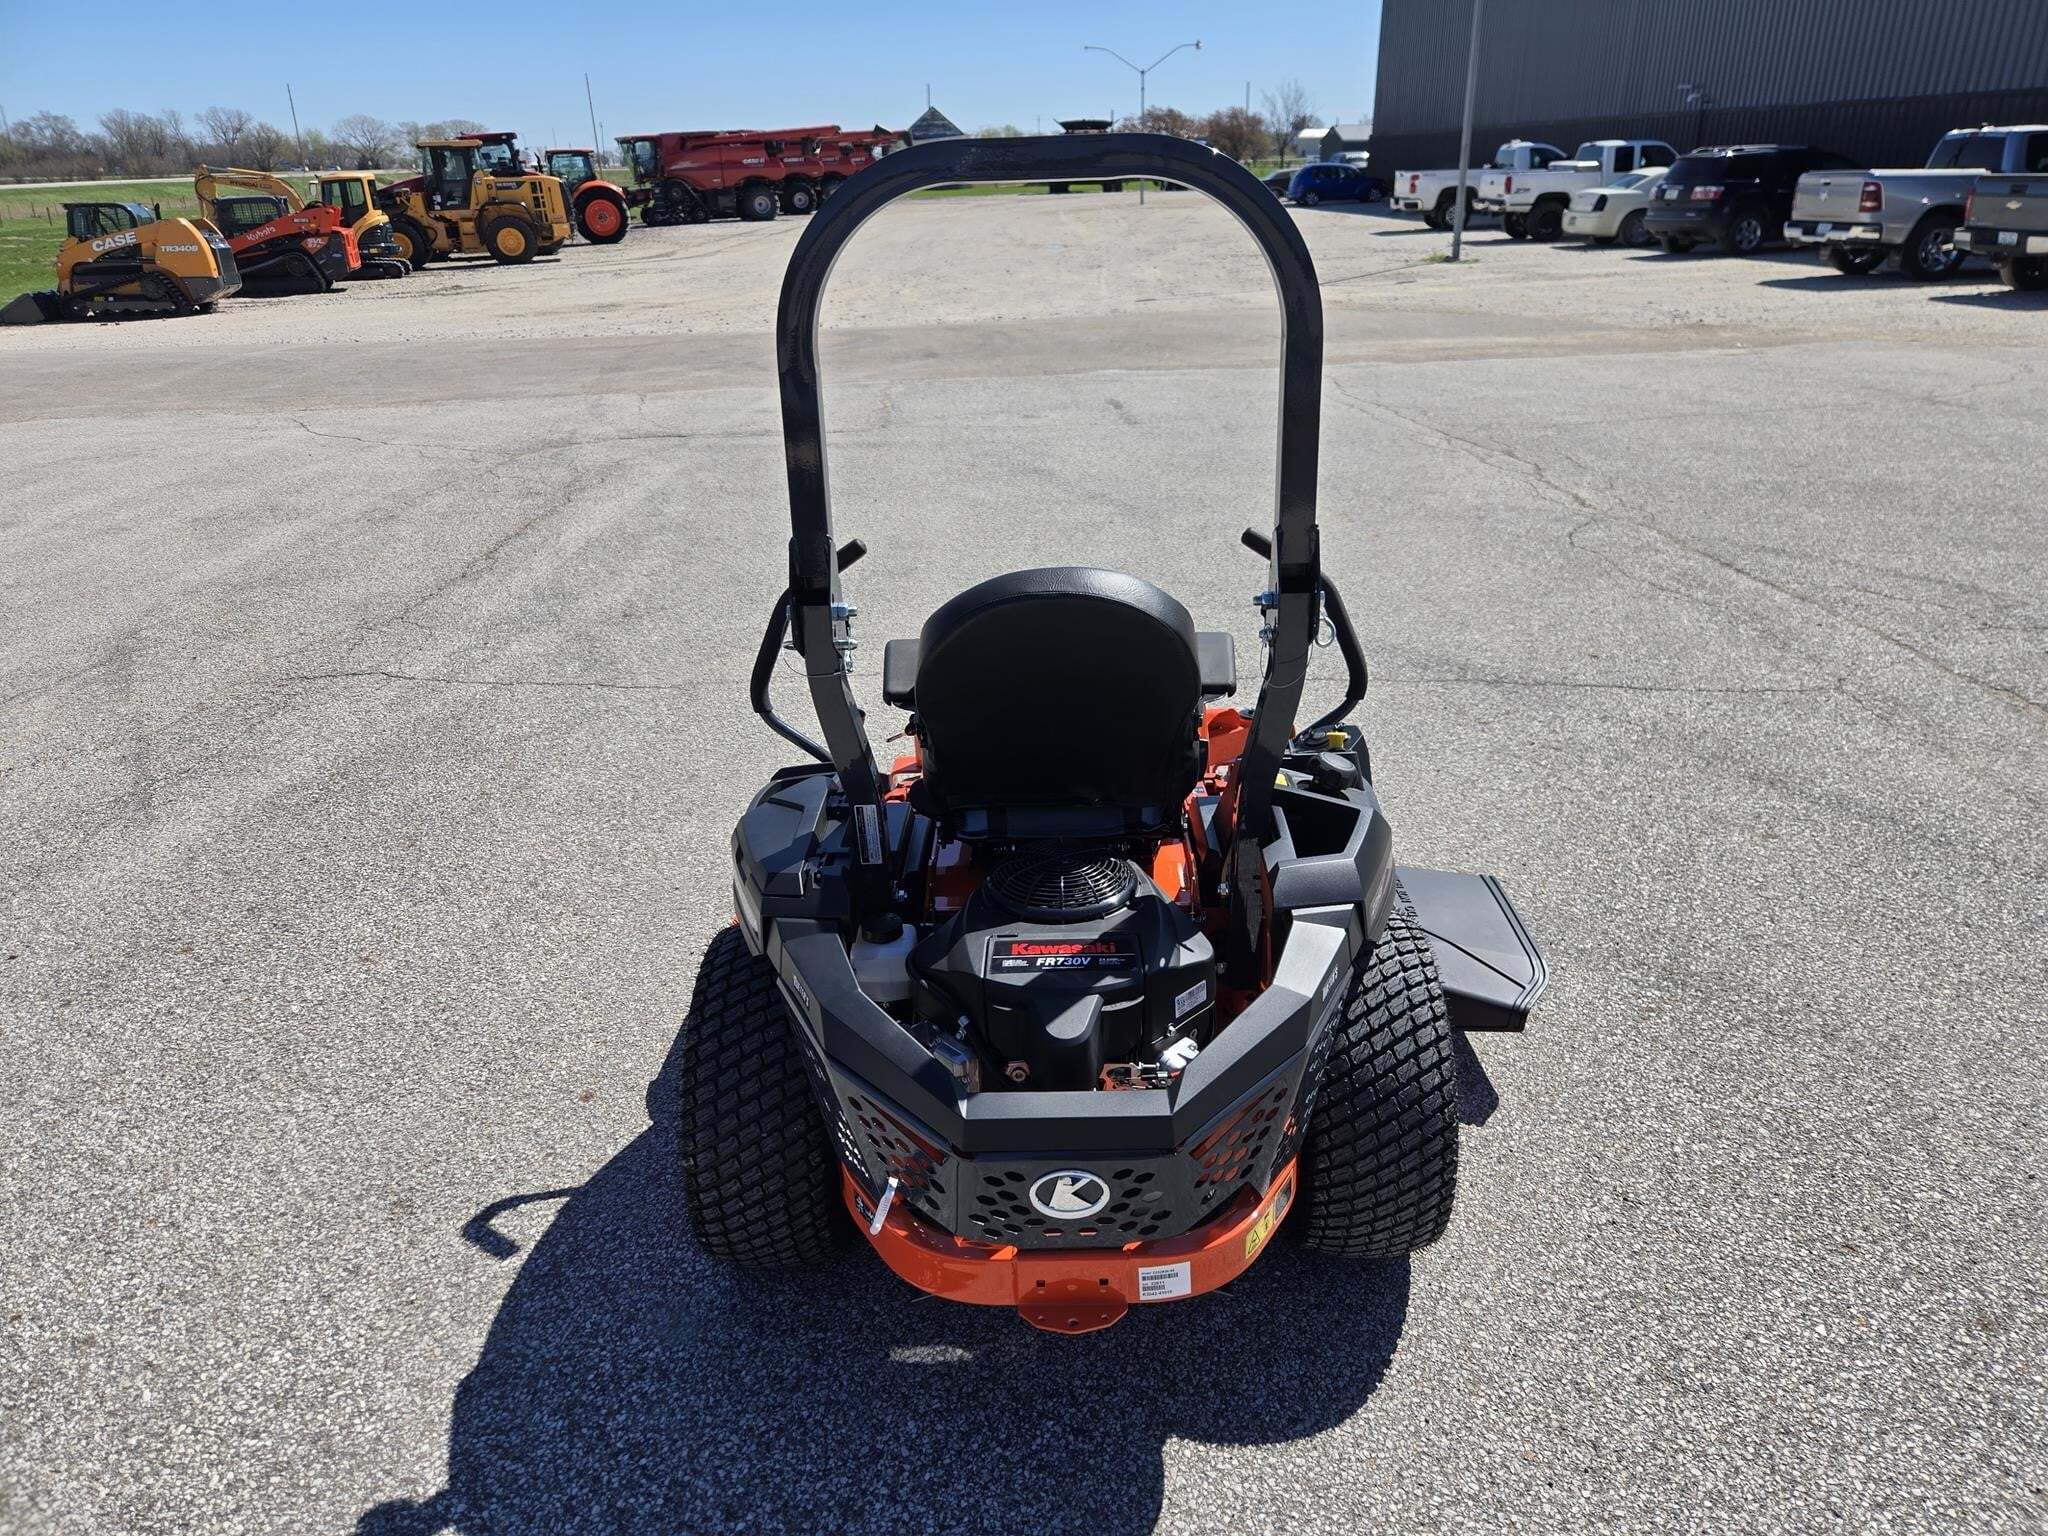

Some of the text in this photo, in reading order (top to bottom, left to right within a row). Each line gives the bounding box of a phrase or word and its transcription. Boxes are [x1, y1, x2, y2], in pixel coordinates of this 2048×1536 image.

[92, 231, 137, 251] CASE
[1011, 942, 1116, 955] Kawasaki
[1036, 957, 1091, 966] FR730V
